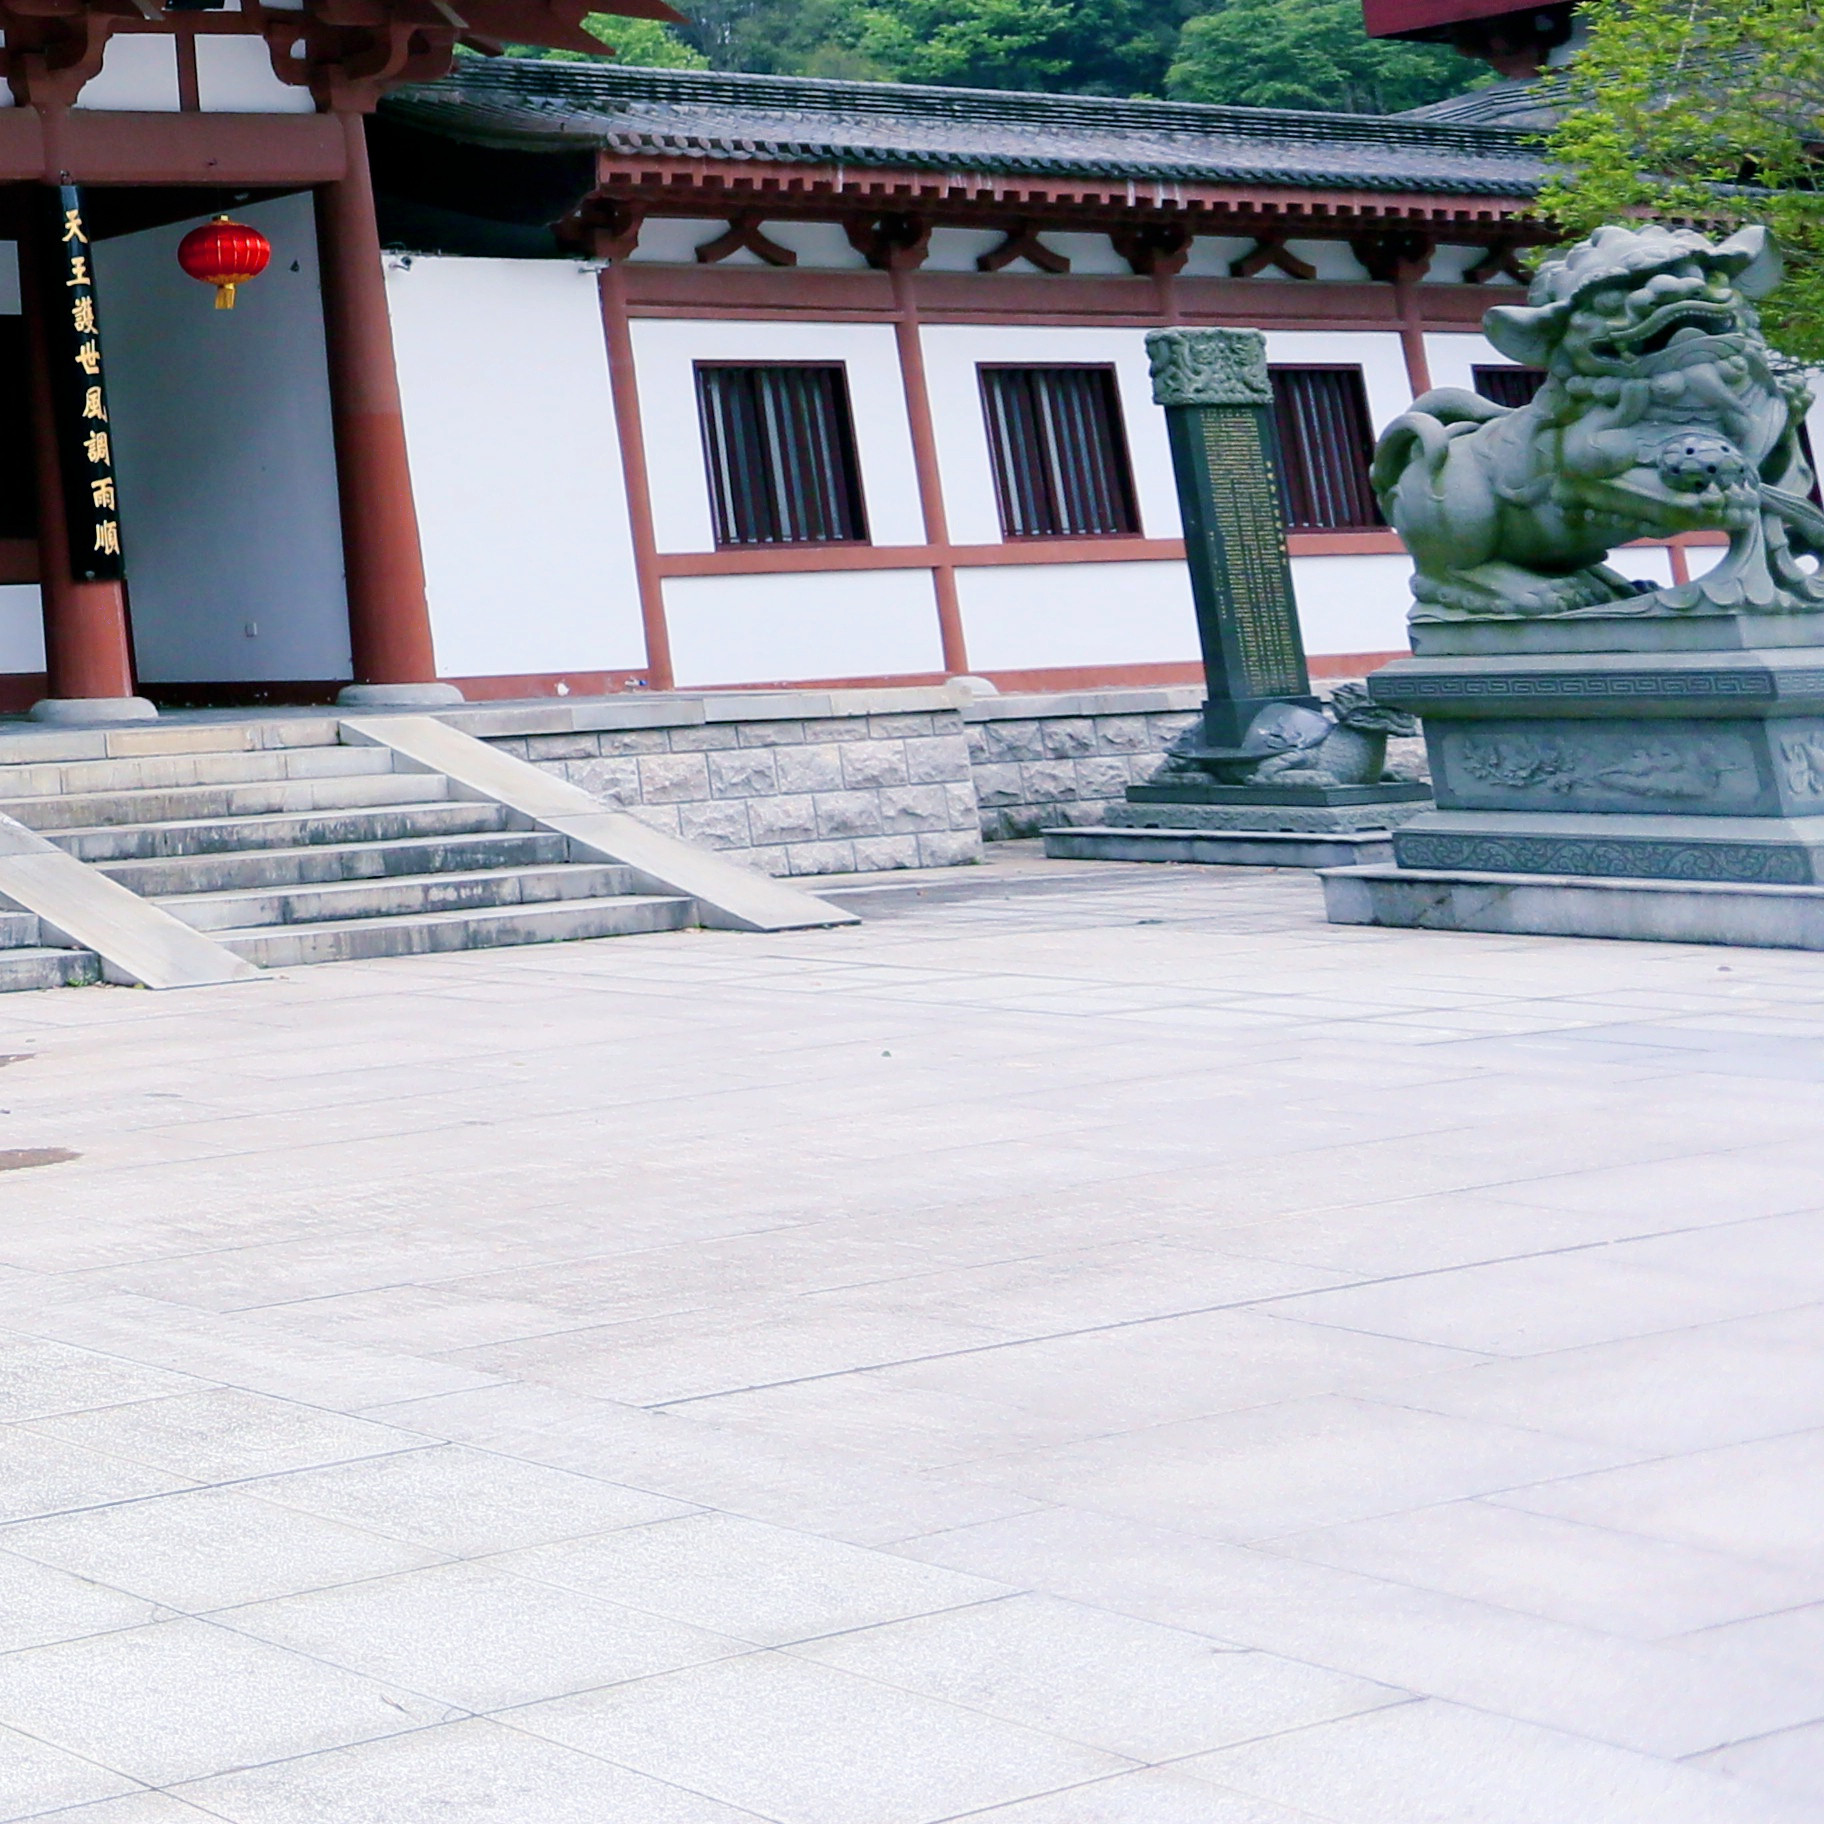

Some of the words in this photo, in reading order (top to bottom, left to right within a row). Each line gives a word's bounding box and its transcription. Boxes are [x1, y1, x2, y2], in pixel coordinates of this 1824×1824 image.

[61, 208, 121, 556] 天王護世風調雨順
